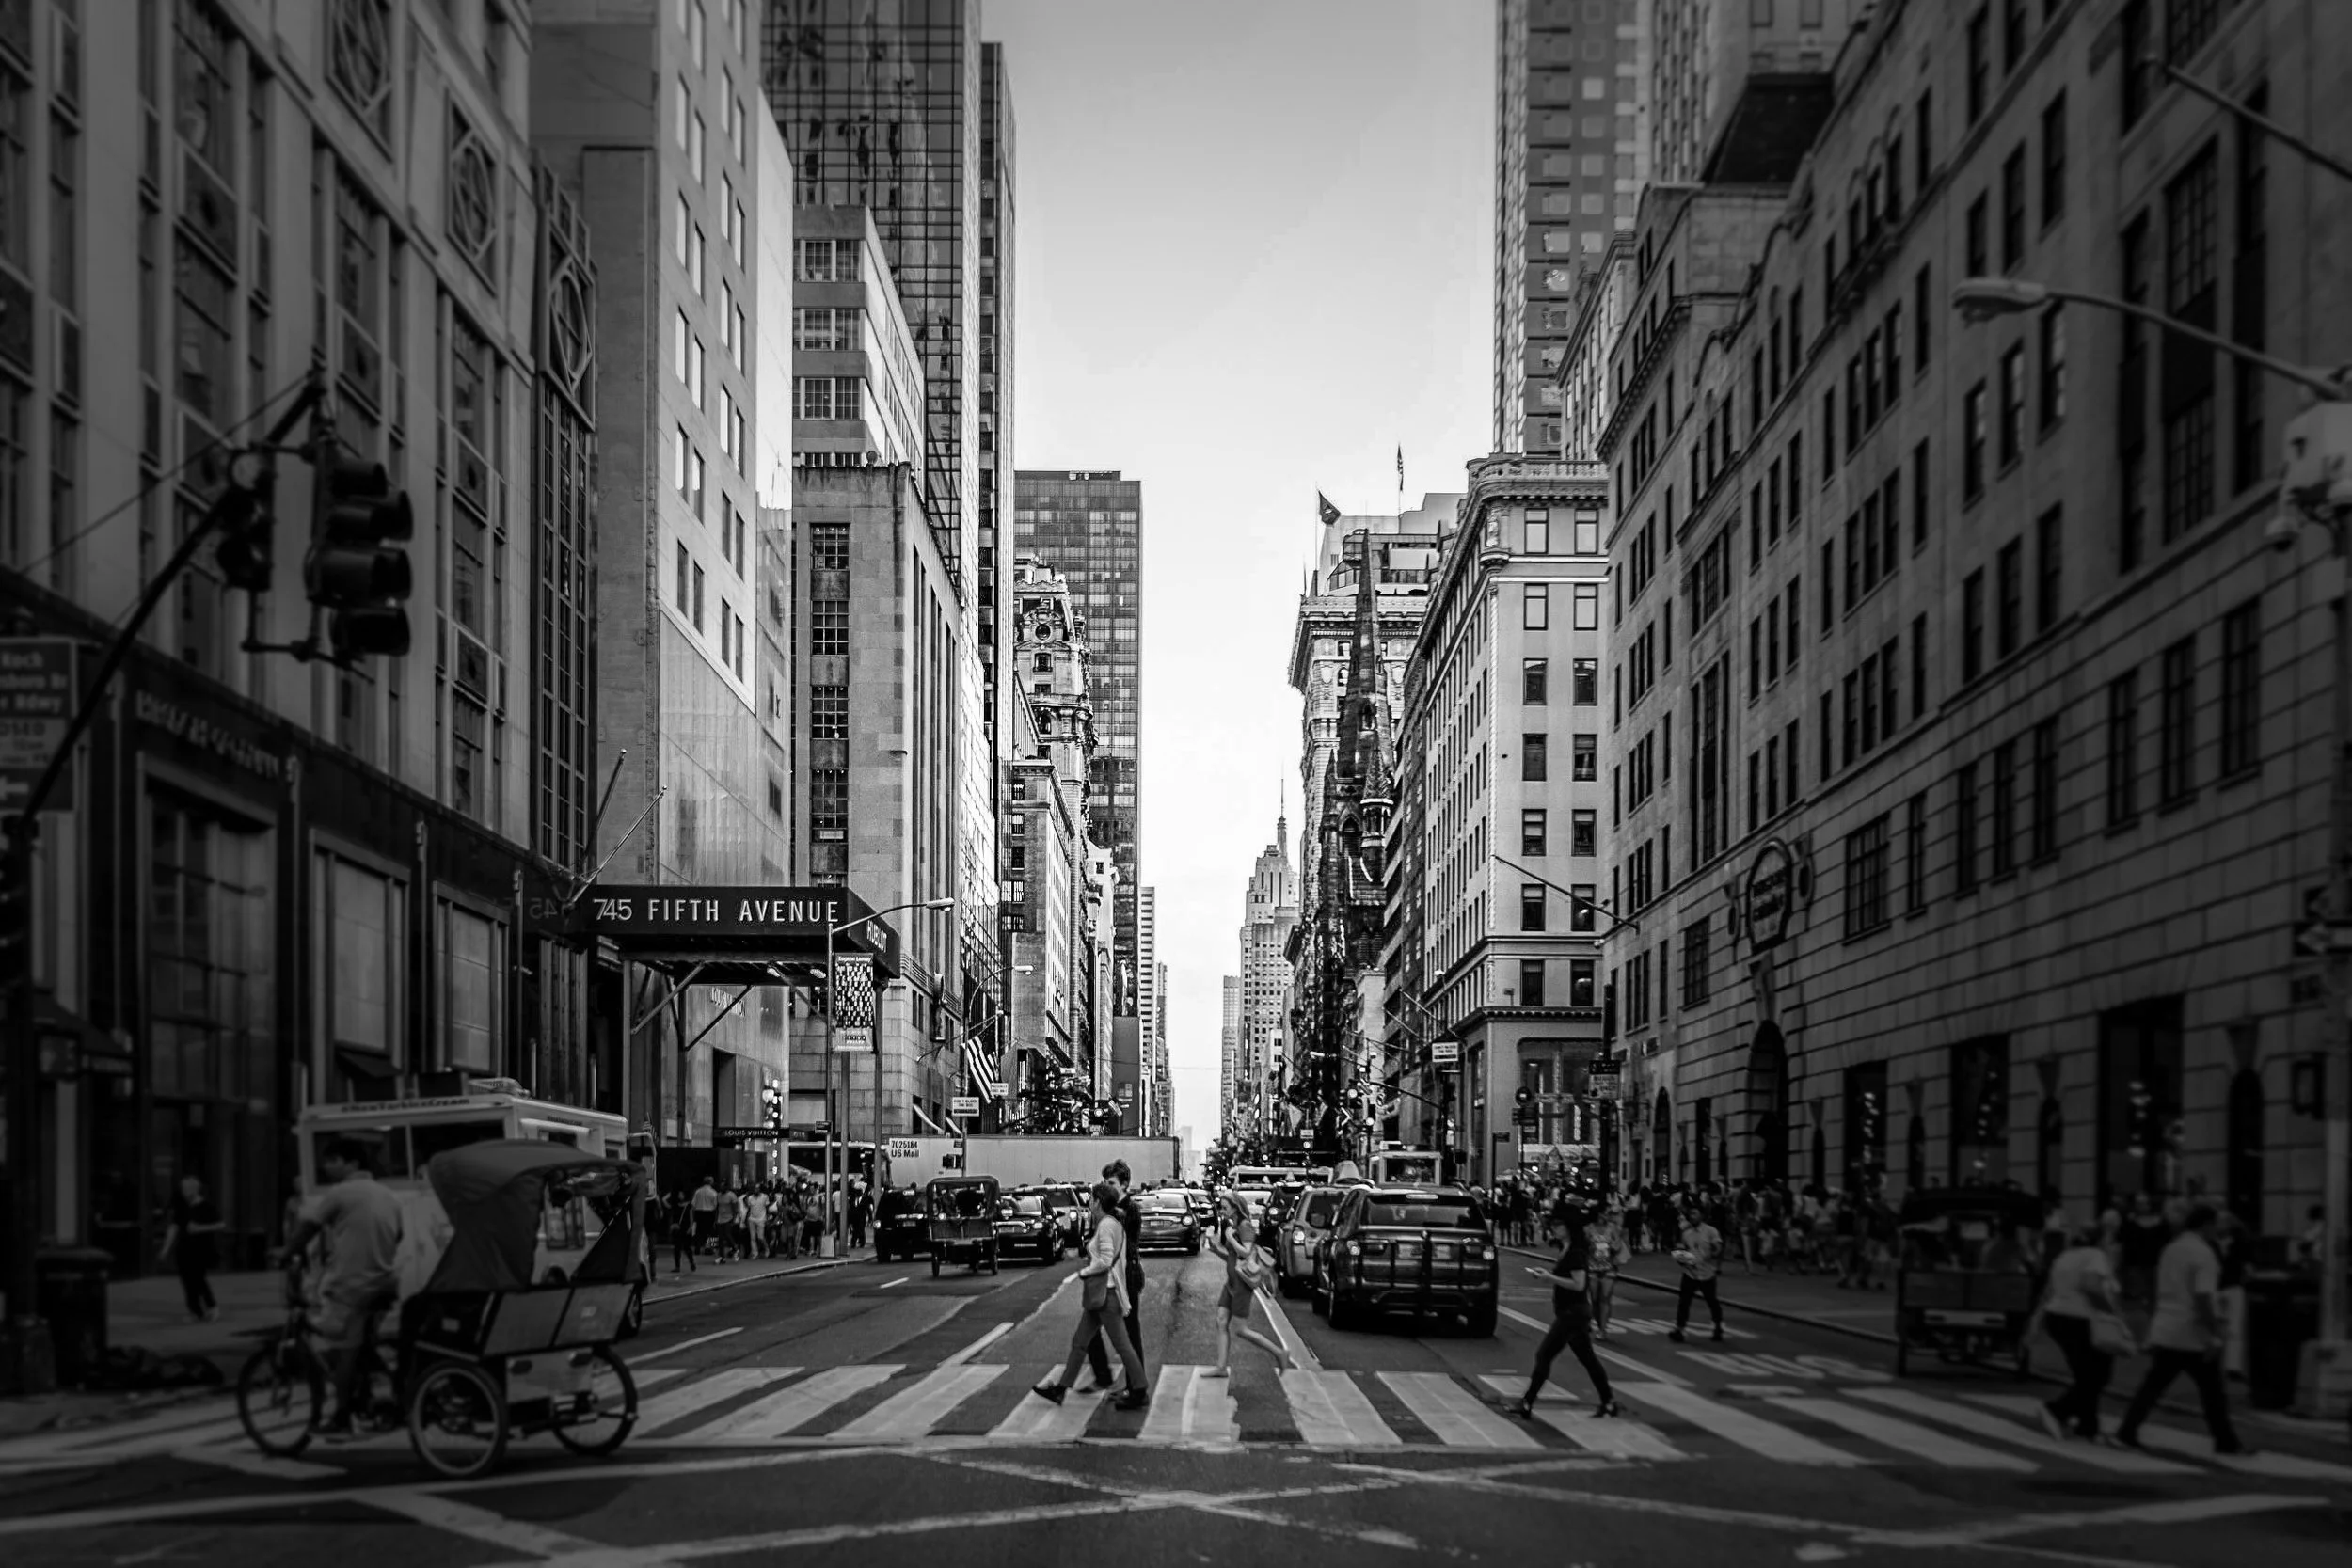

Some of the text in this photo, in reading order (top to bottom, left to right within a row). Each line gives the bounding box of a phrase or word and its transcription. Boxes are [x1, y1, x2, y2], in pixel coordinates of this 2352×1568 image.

[593, 898, 839, 923] 745 FIFTH AVENUE
[891, 1149, 919, 1158] US Mail
